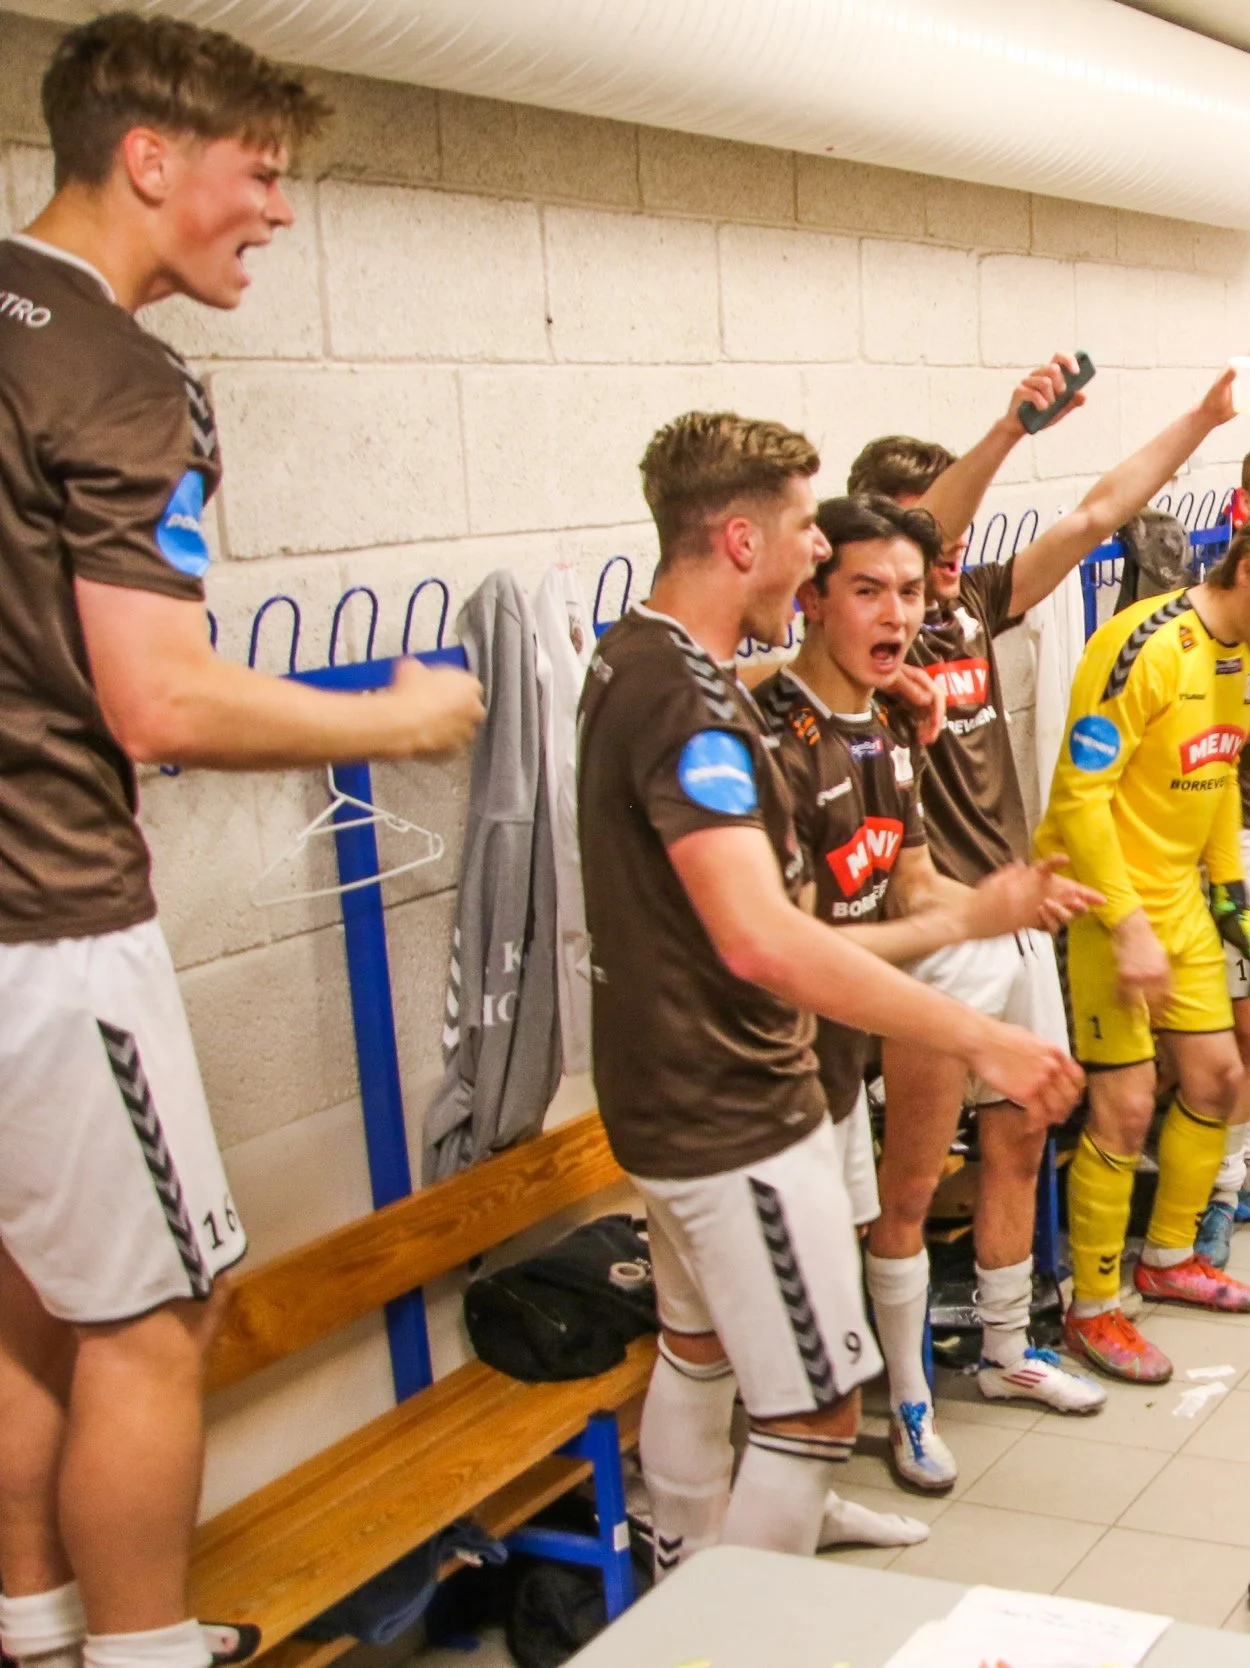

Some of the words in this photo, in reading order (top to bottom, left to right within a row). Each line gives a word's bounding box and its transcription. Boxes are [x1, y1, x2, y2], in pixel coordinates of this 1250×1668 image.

[1189, 732, 1241, 765] MENY
[1170, 776, 1225, 791] BORREVE
[846, 828, 900, 880] MNY
[1235, 958, 1248, 982] 1
[1088, 1014, 1104, 1040] 1
[203, 1208, 236, 1251] 16
[844, 1330, 862, 1366] 9
